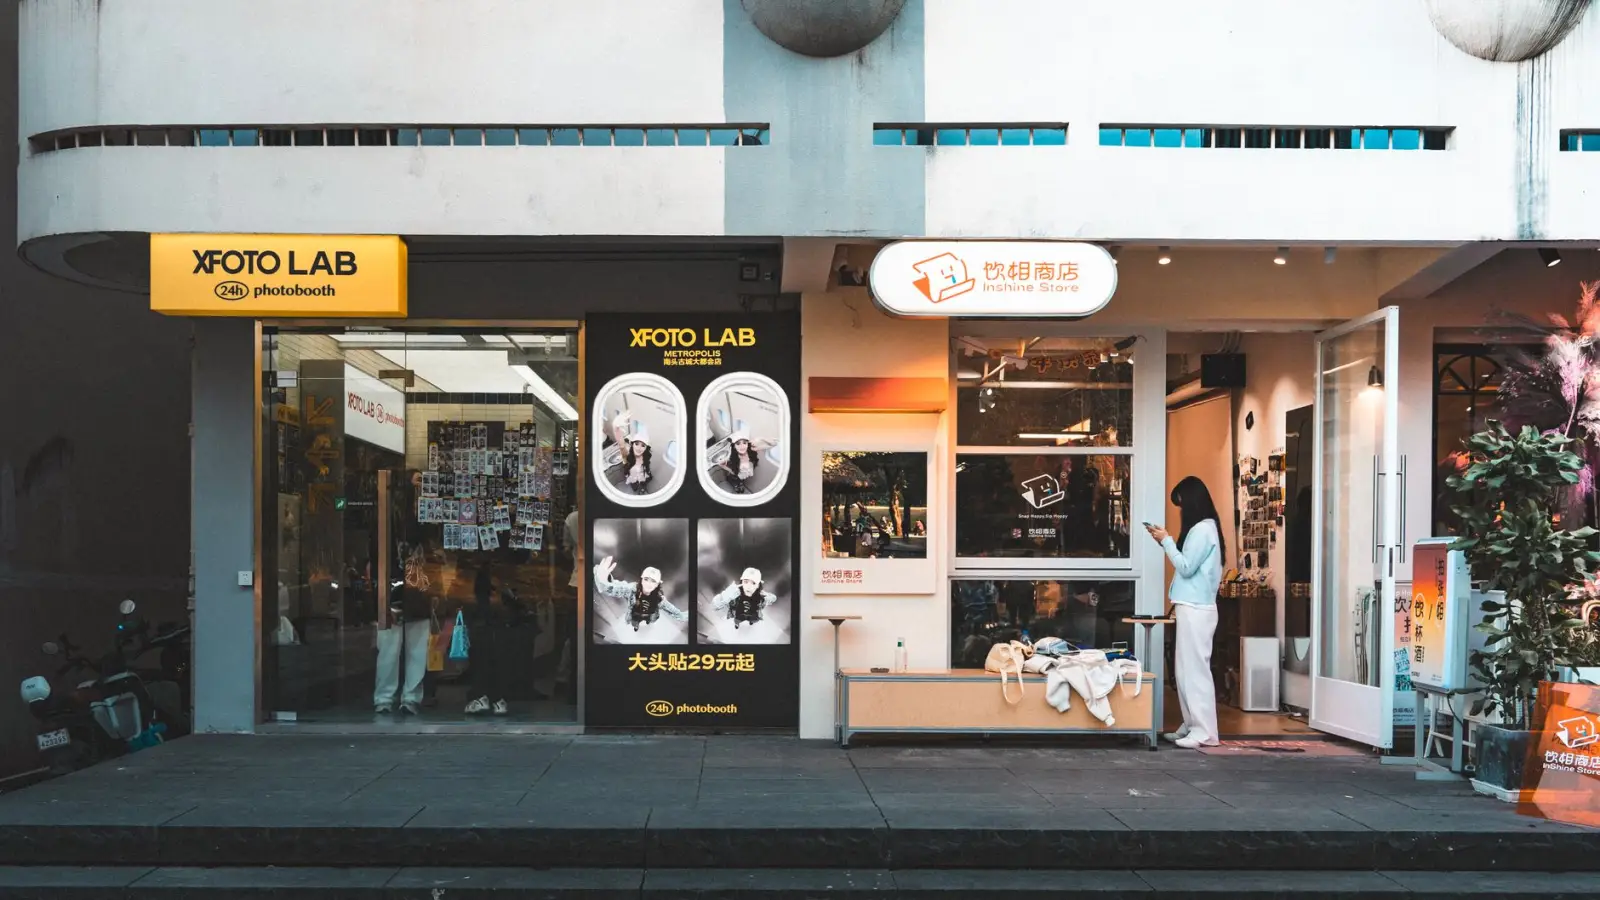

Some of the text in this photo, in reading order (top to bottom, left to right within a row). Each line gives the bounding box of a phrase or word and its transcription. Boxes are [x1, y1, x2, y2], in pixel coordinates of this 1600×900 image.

[192, 249, 358, 276] XFOTO LAB
[983, 261, 1079, 281] 饮相商店
[220, 284, 336, 299] 24h photobooth
[1039, 282, 1079, 292] Store
[629, 328, 756, 347] XFOTO LAB
[363, 400, 375, 418] LAB
[822, 570, 863, 579] 饮相商店
[628, 653, 755, 672] 大头贴29元起
[650, 704, 737, 715] 24h photobooth
